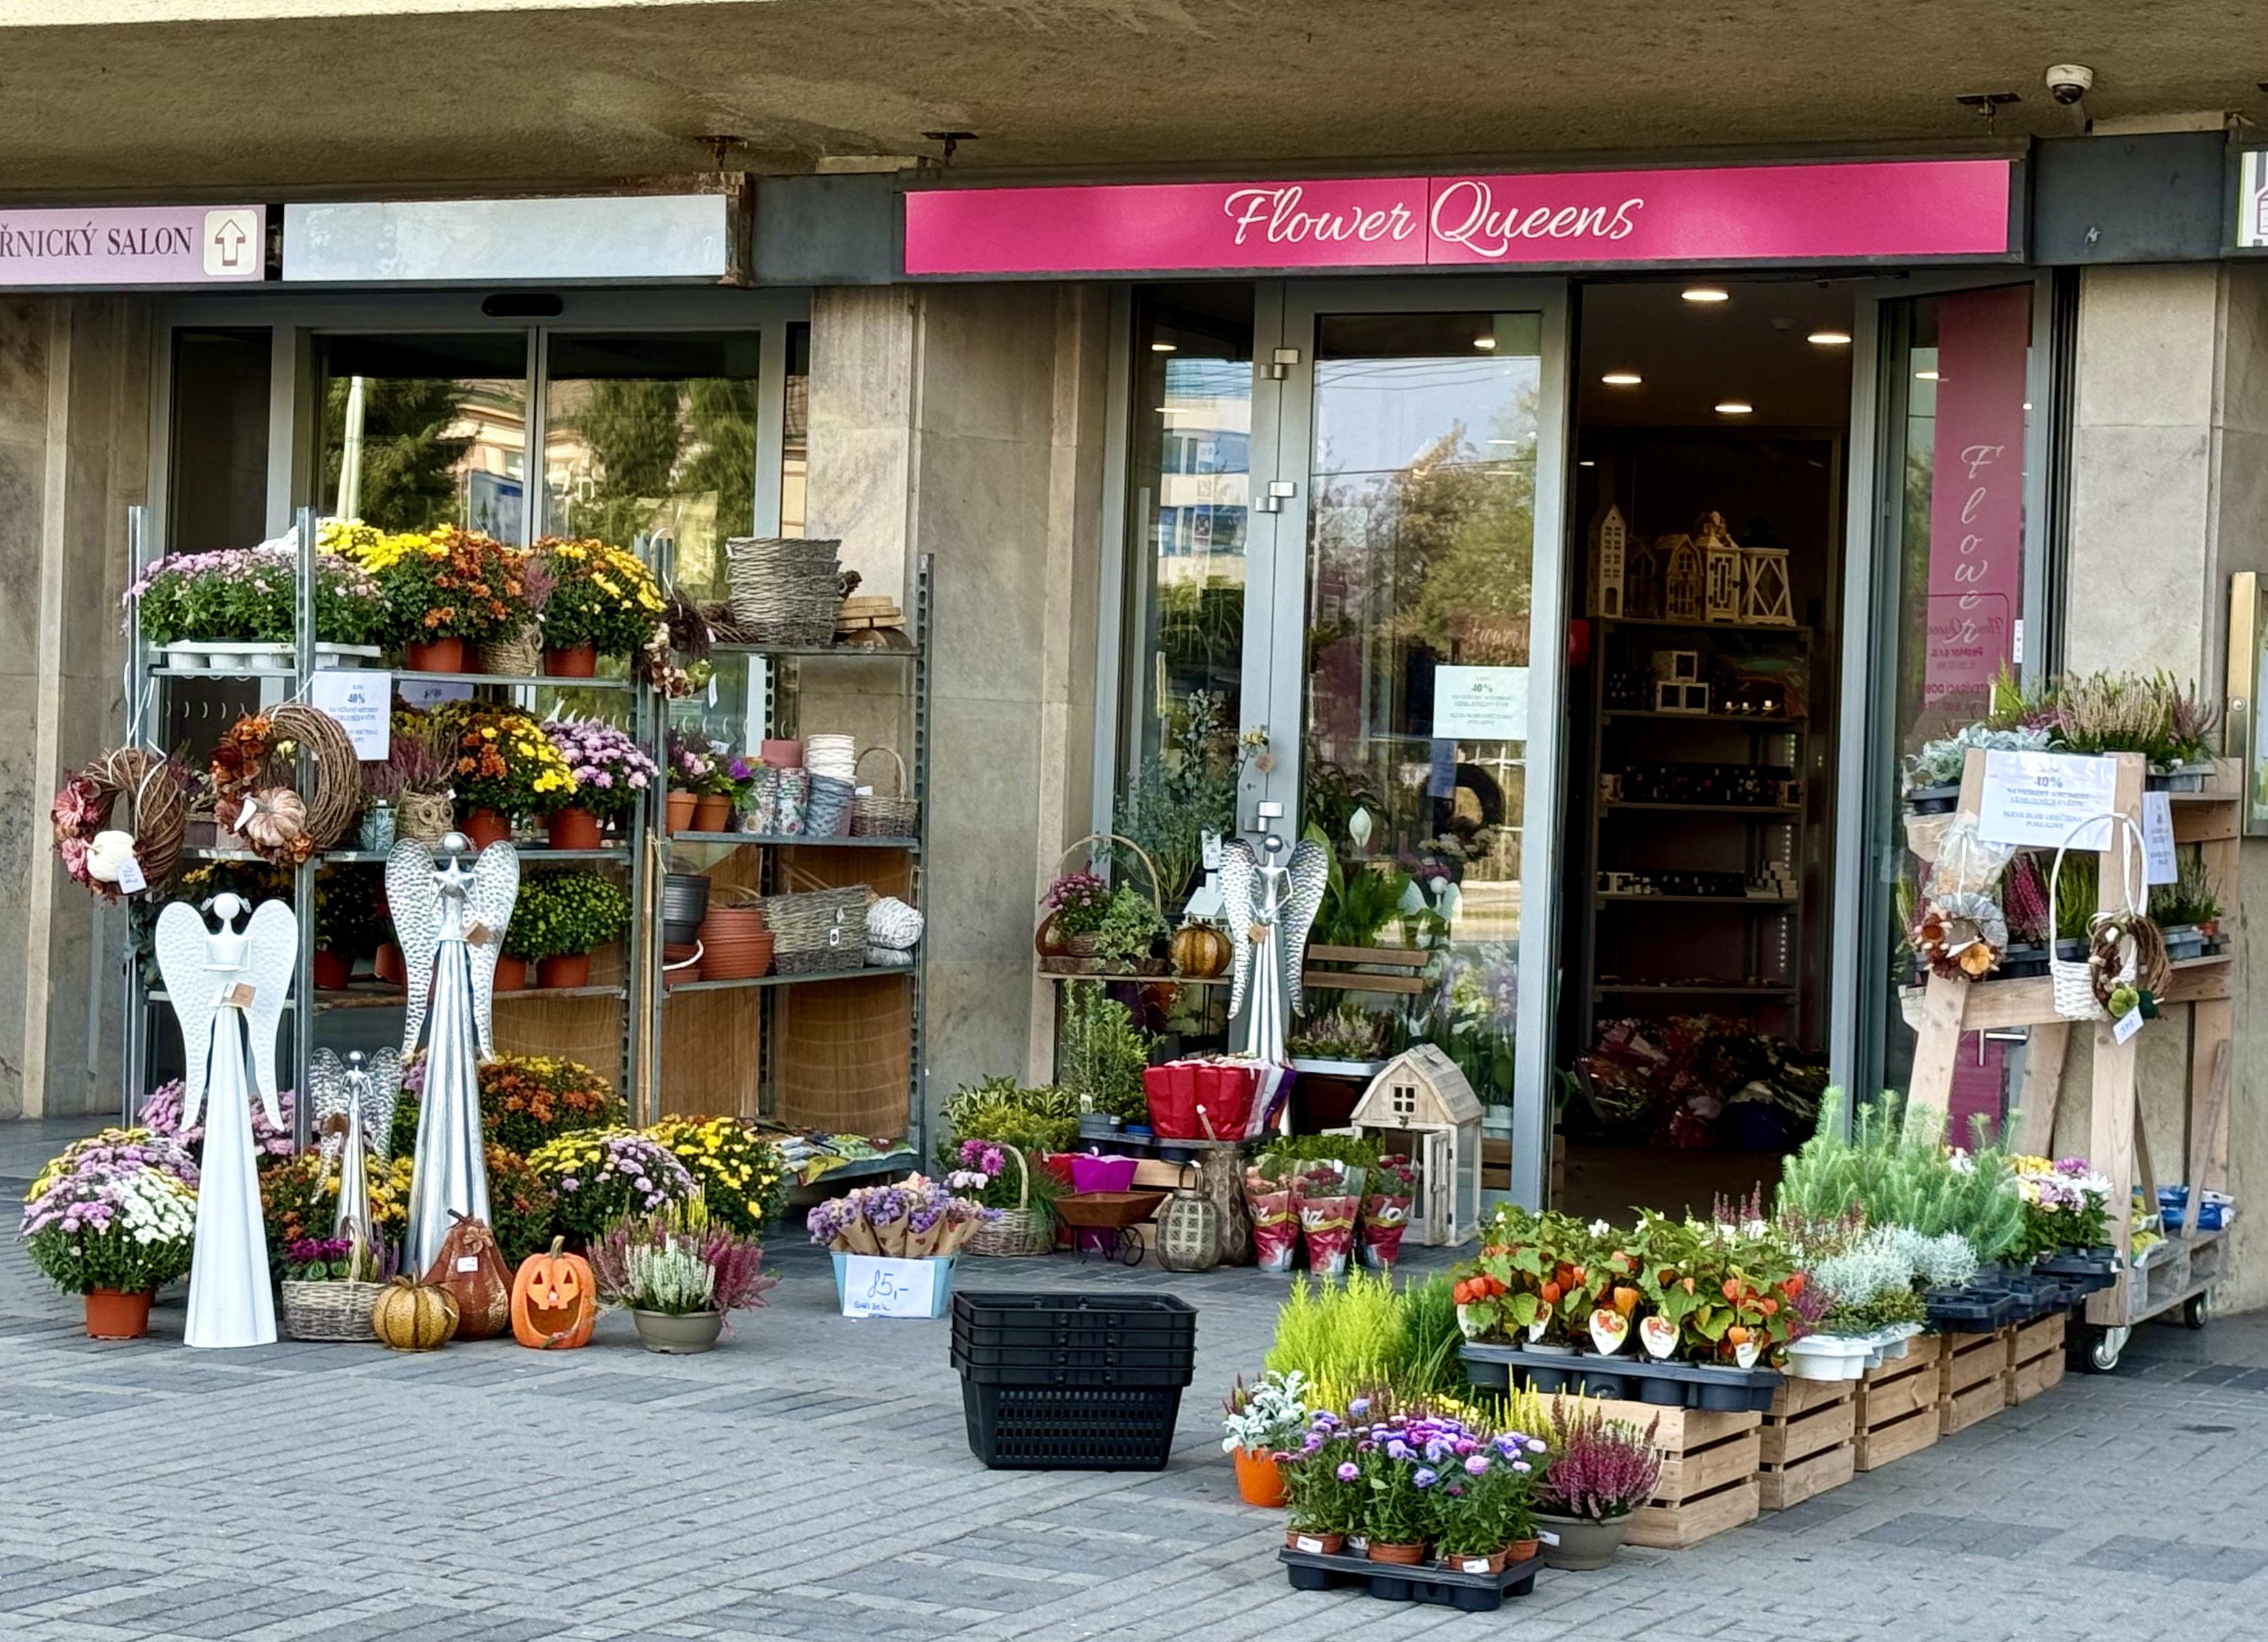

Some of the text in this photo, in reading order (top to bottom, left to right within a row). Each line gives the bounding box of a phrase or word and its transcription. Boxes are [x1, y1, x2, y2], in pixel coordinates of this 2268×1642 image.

[108, 227, 193, 255] SALON
[1225, 180, 1644, 257] Flower Queens
